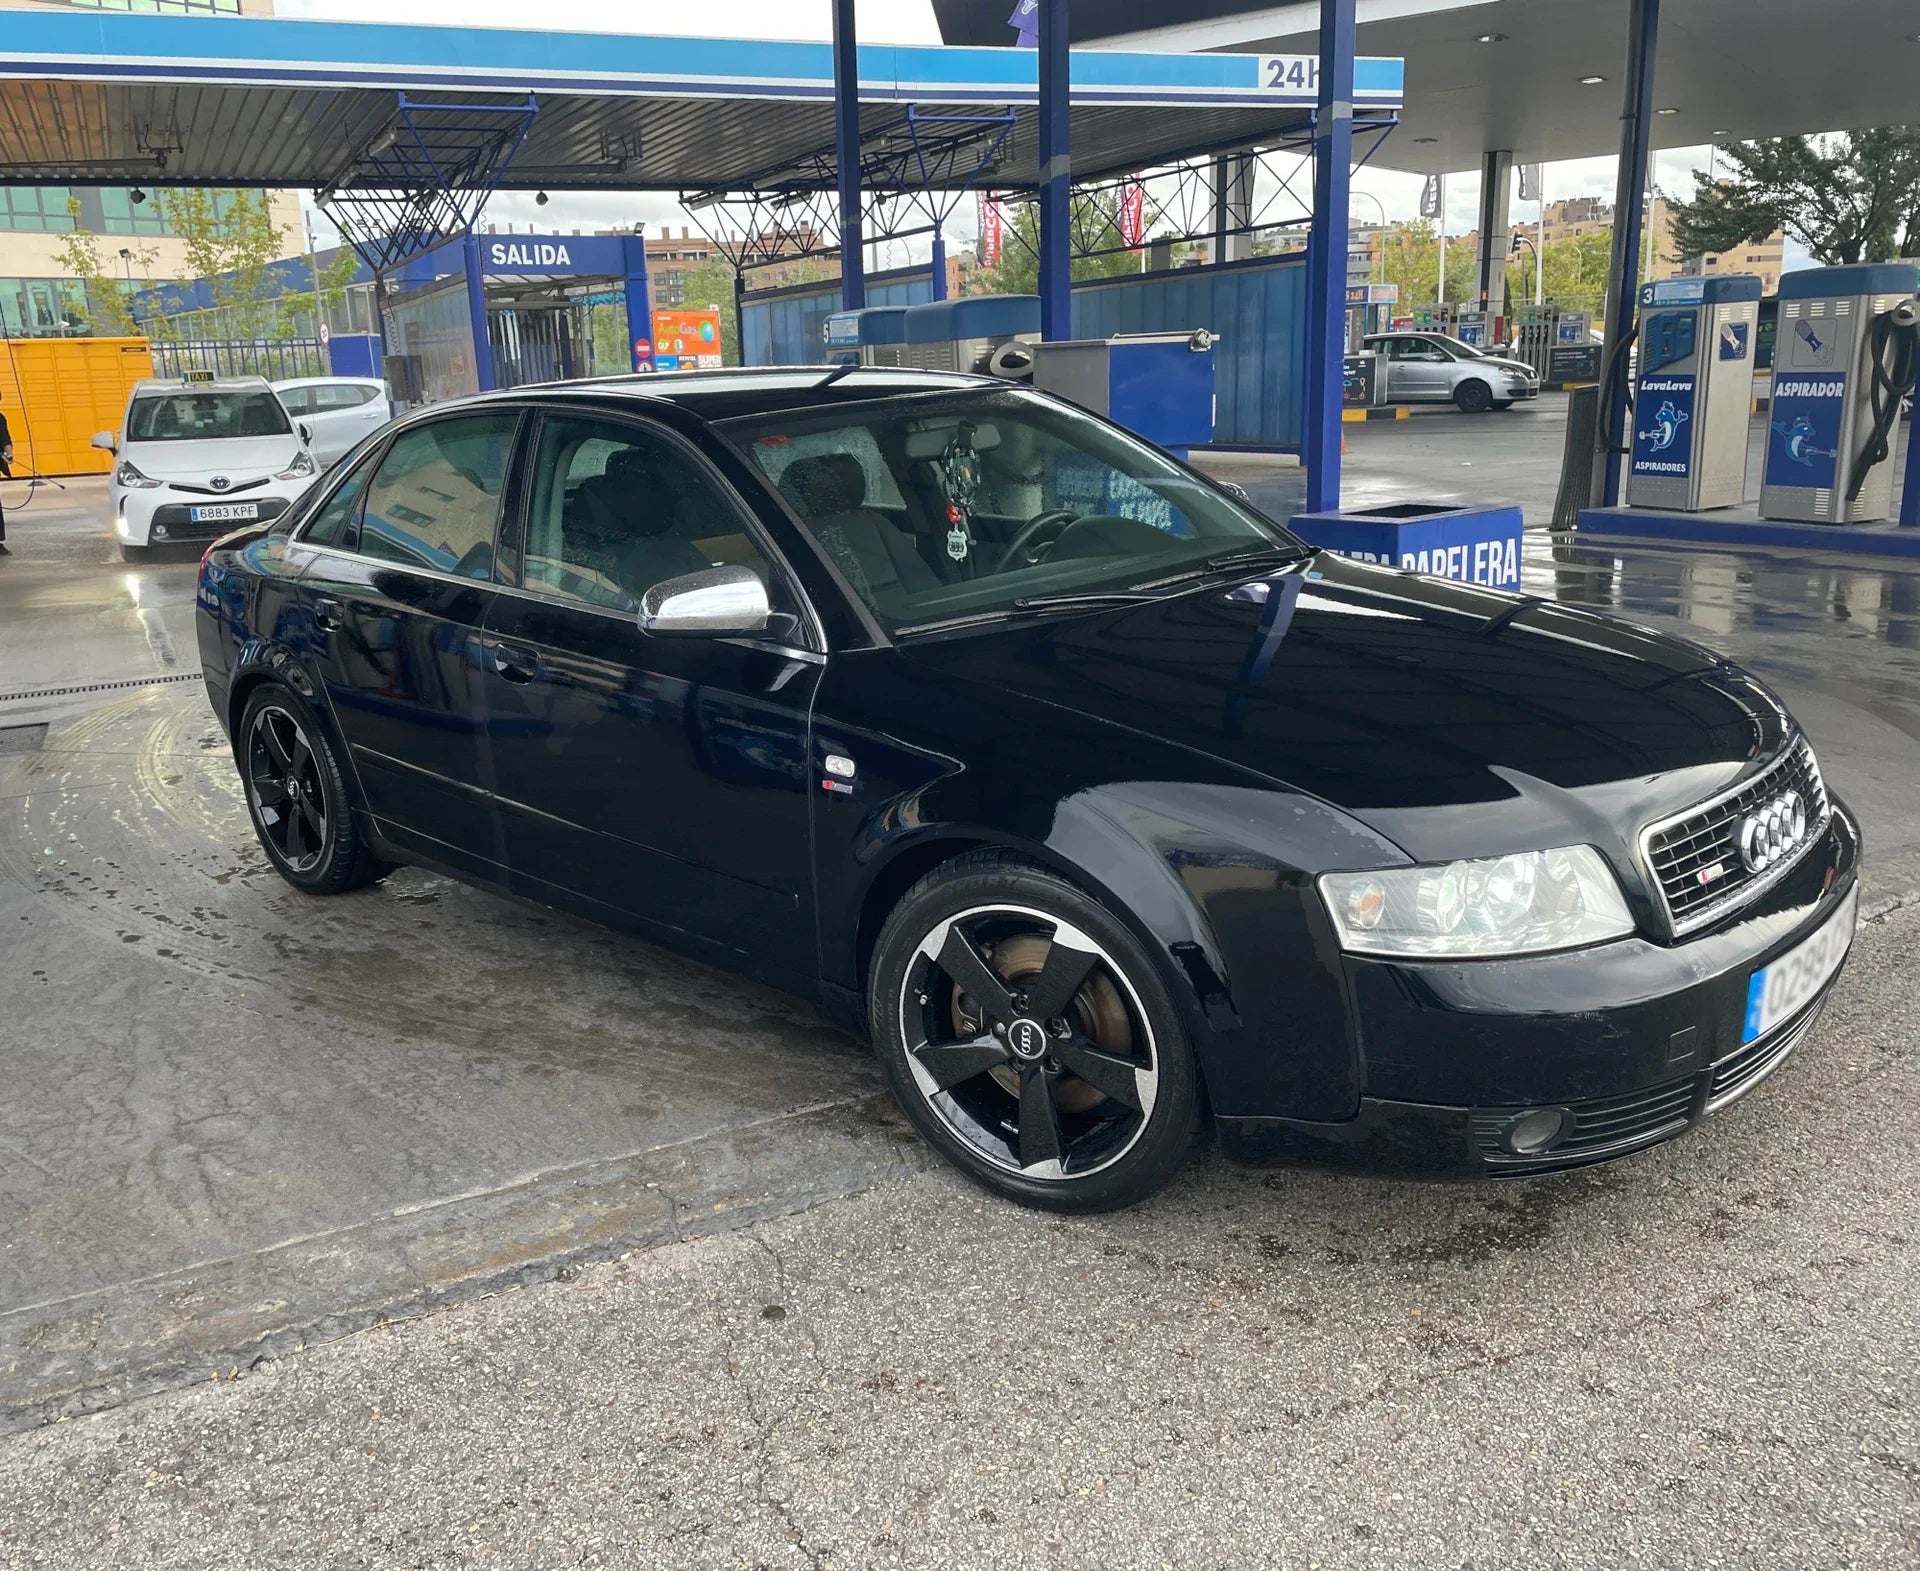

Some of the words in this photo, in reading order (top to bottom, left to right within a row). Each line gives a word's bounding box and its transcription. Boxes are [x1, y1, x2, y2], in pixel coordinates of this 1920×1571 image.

[1267, 58, 1319, 88] 24h
[491, 243, 571, 265] SALIDA
[1643, 288, 1653, 304] 3
[190, 371, 208, 382] TAXI
[1640, 380, 1692, 391] LavaLava
[1775, 382, 1844, 397] ASPIRADOR
[1635, 461, 1686, 473] ASPIRADORES
[200, 508, 229, 519] 6883
